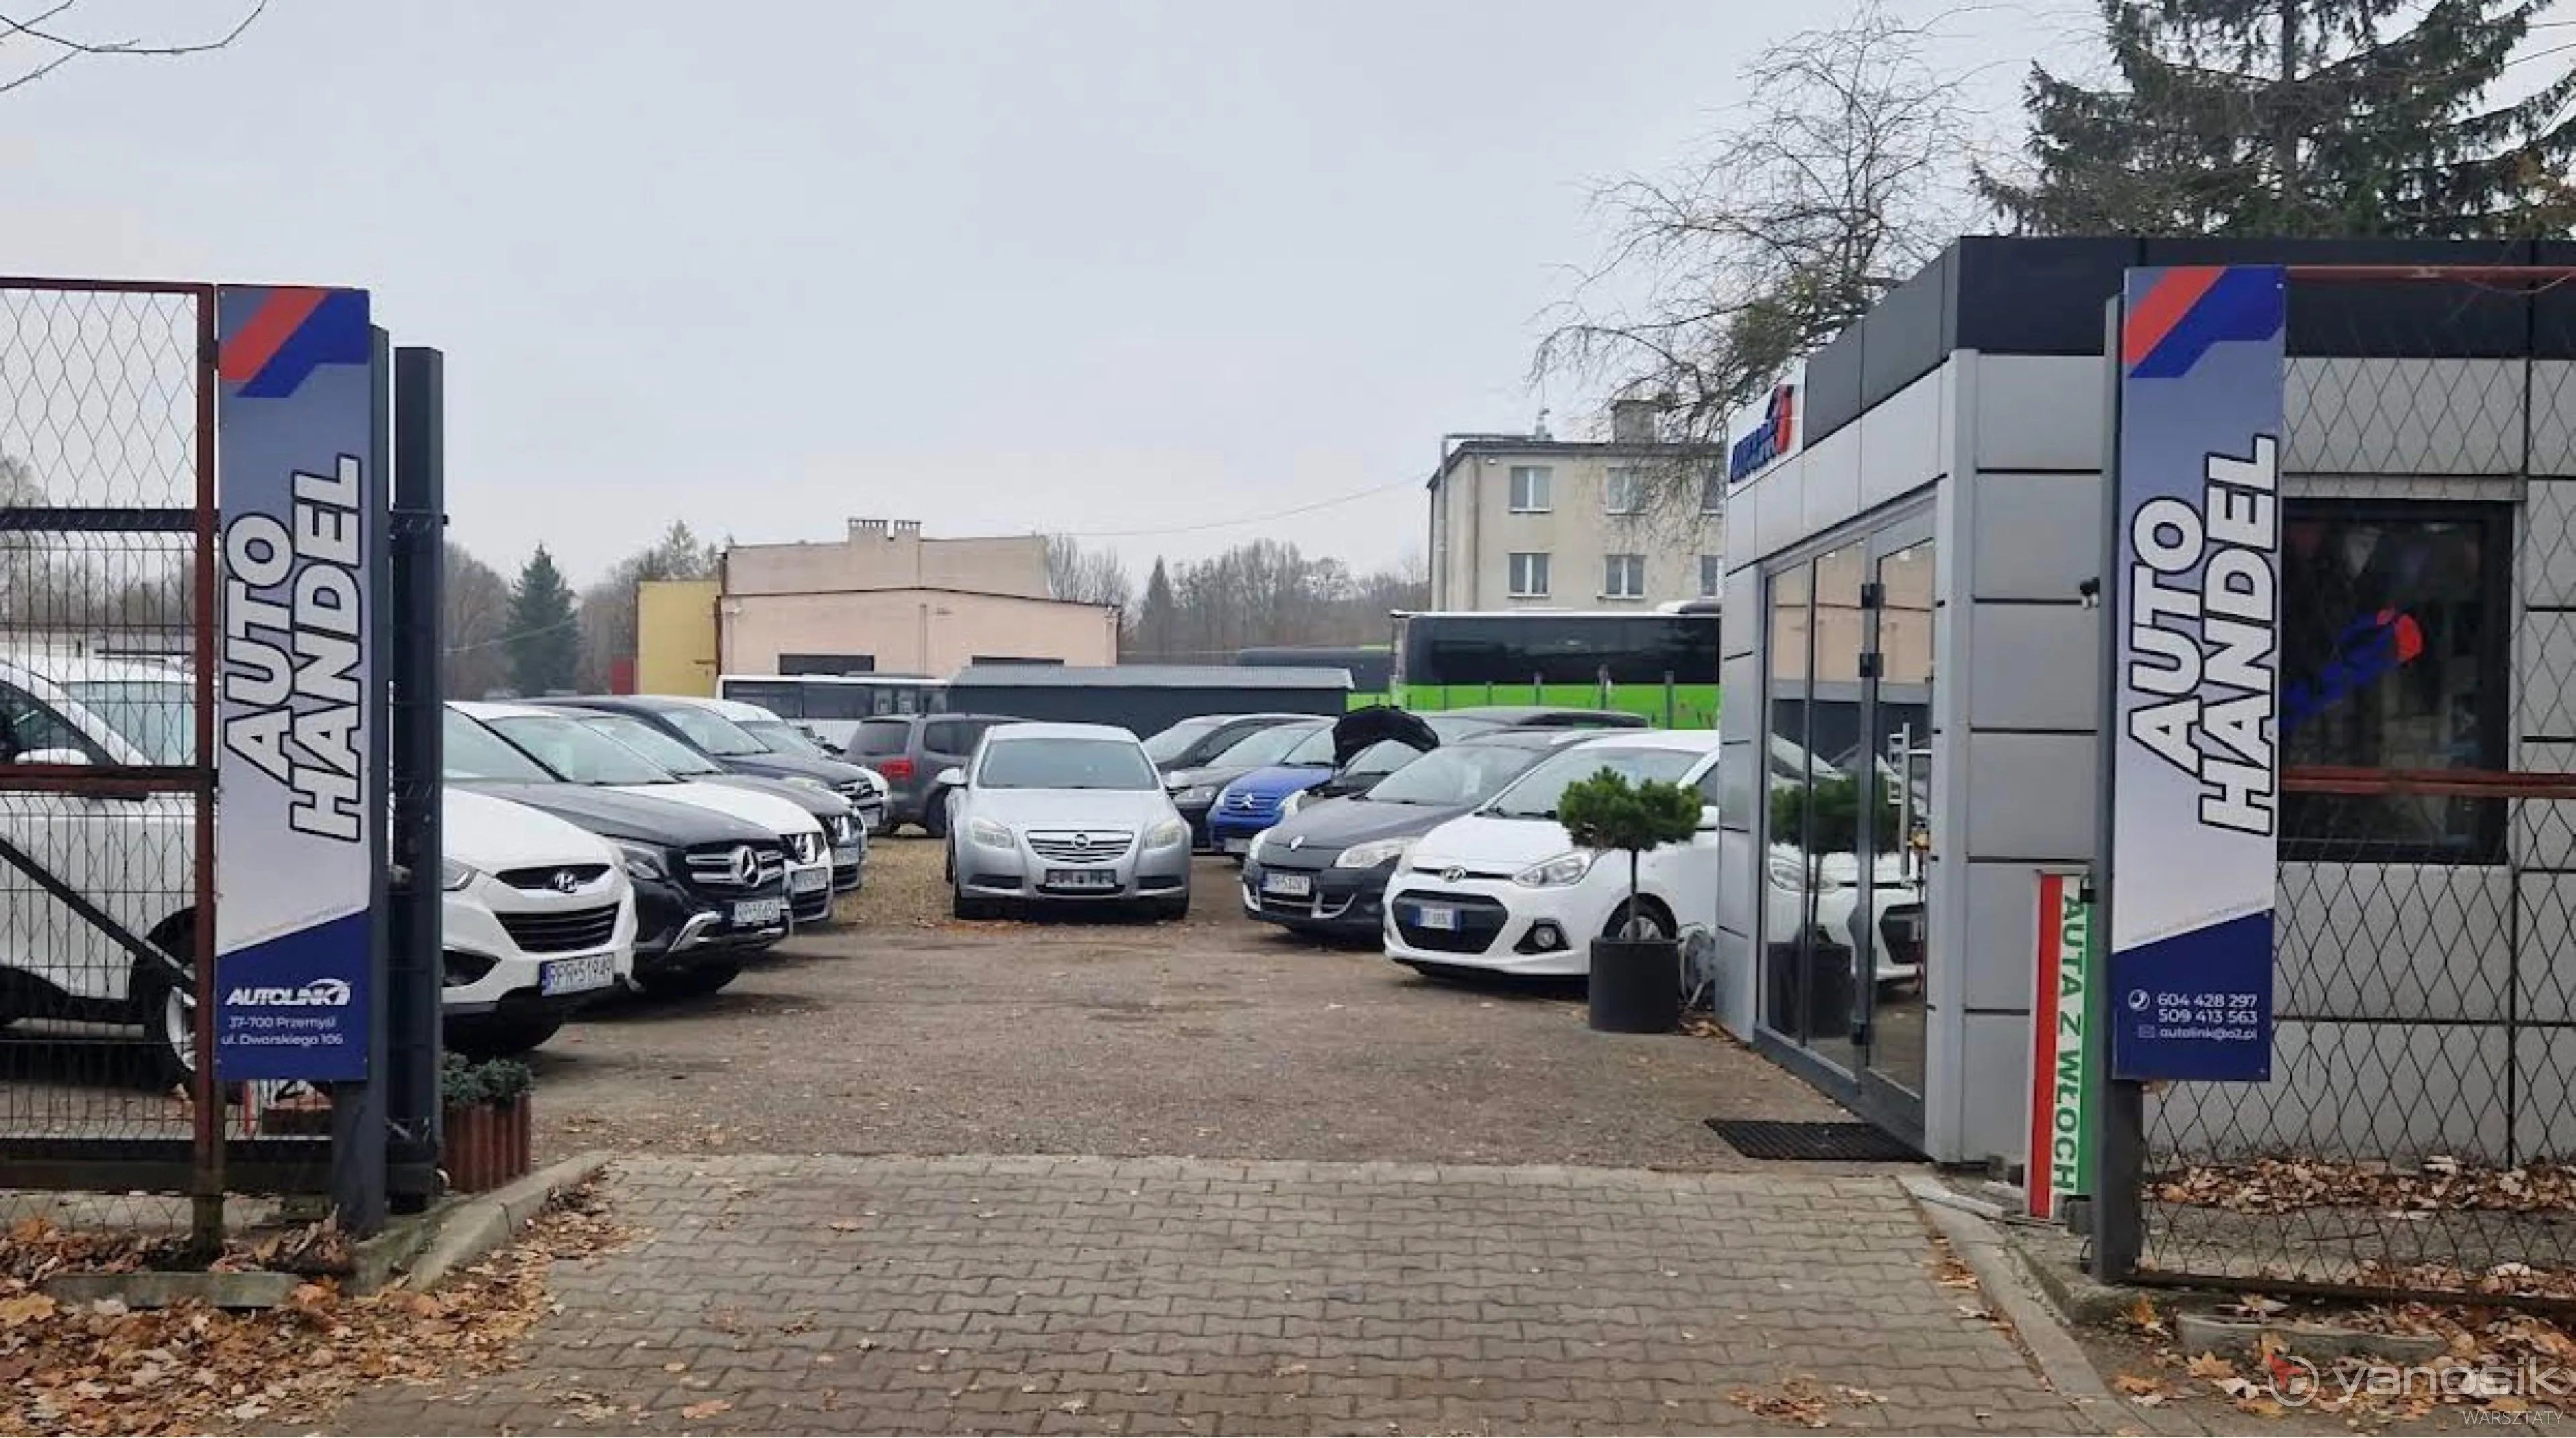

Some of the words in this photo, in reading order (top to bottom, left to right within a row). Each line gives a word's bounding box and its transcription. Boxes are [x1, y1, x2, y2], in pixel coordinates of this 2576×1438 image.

[225, 512, 294, 785] AUTO
[288, 453, 362, 841] HANDEL
[2129, 496, 2204, 778] AUTO
[2199, 433, 2279, 836] HANDEL
[2061, 895, 2086, 997] AUTA
[2059, 1013, 2081, 1037] Z
[2157, 993, 2190, 1006] 604
[2193, 993, 2225, 1007] 428
[2228, 993, 2258, 1007] 297
[2157, 1009, 2192, 1023] 509
[2194, 1010, 2224, 1024] 413
[2227, 1011, 2258, 1024] 563
[2159, 1026, 2258, 1040] autolink@o2.pl
